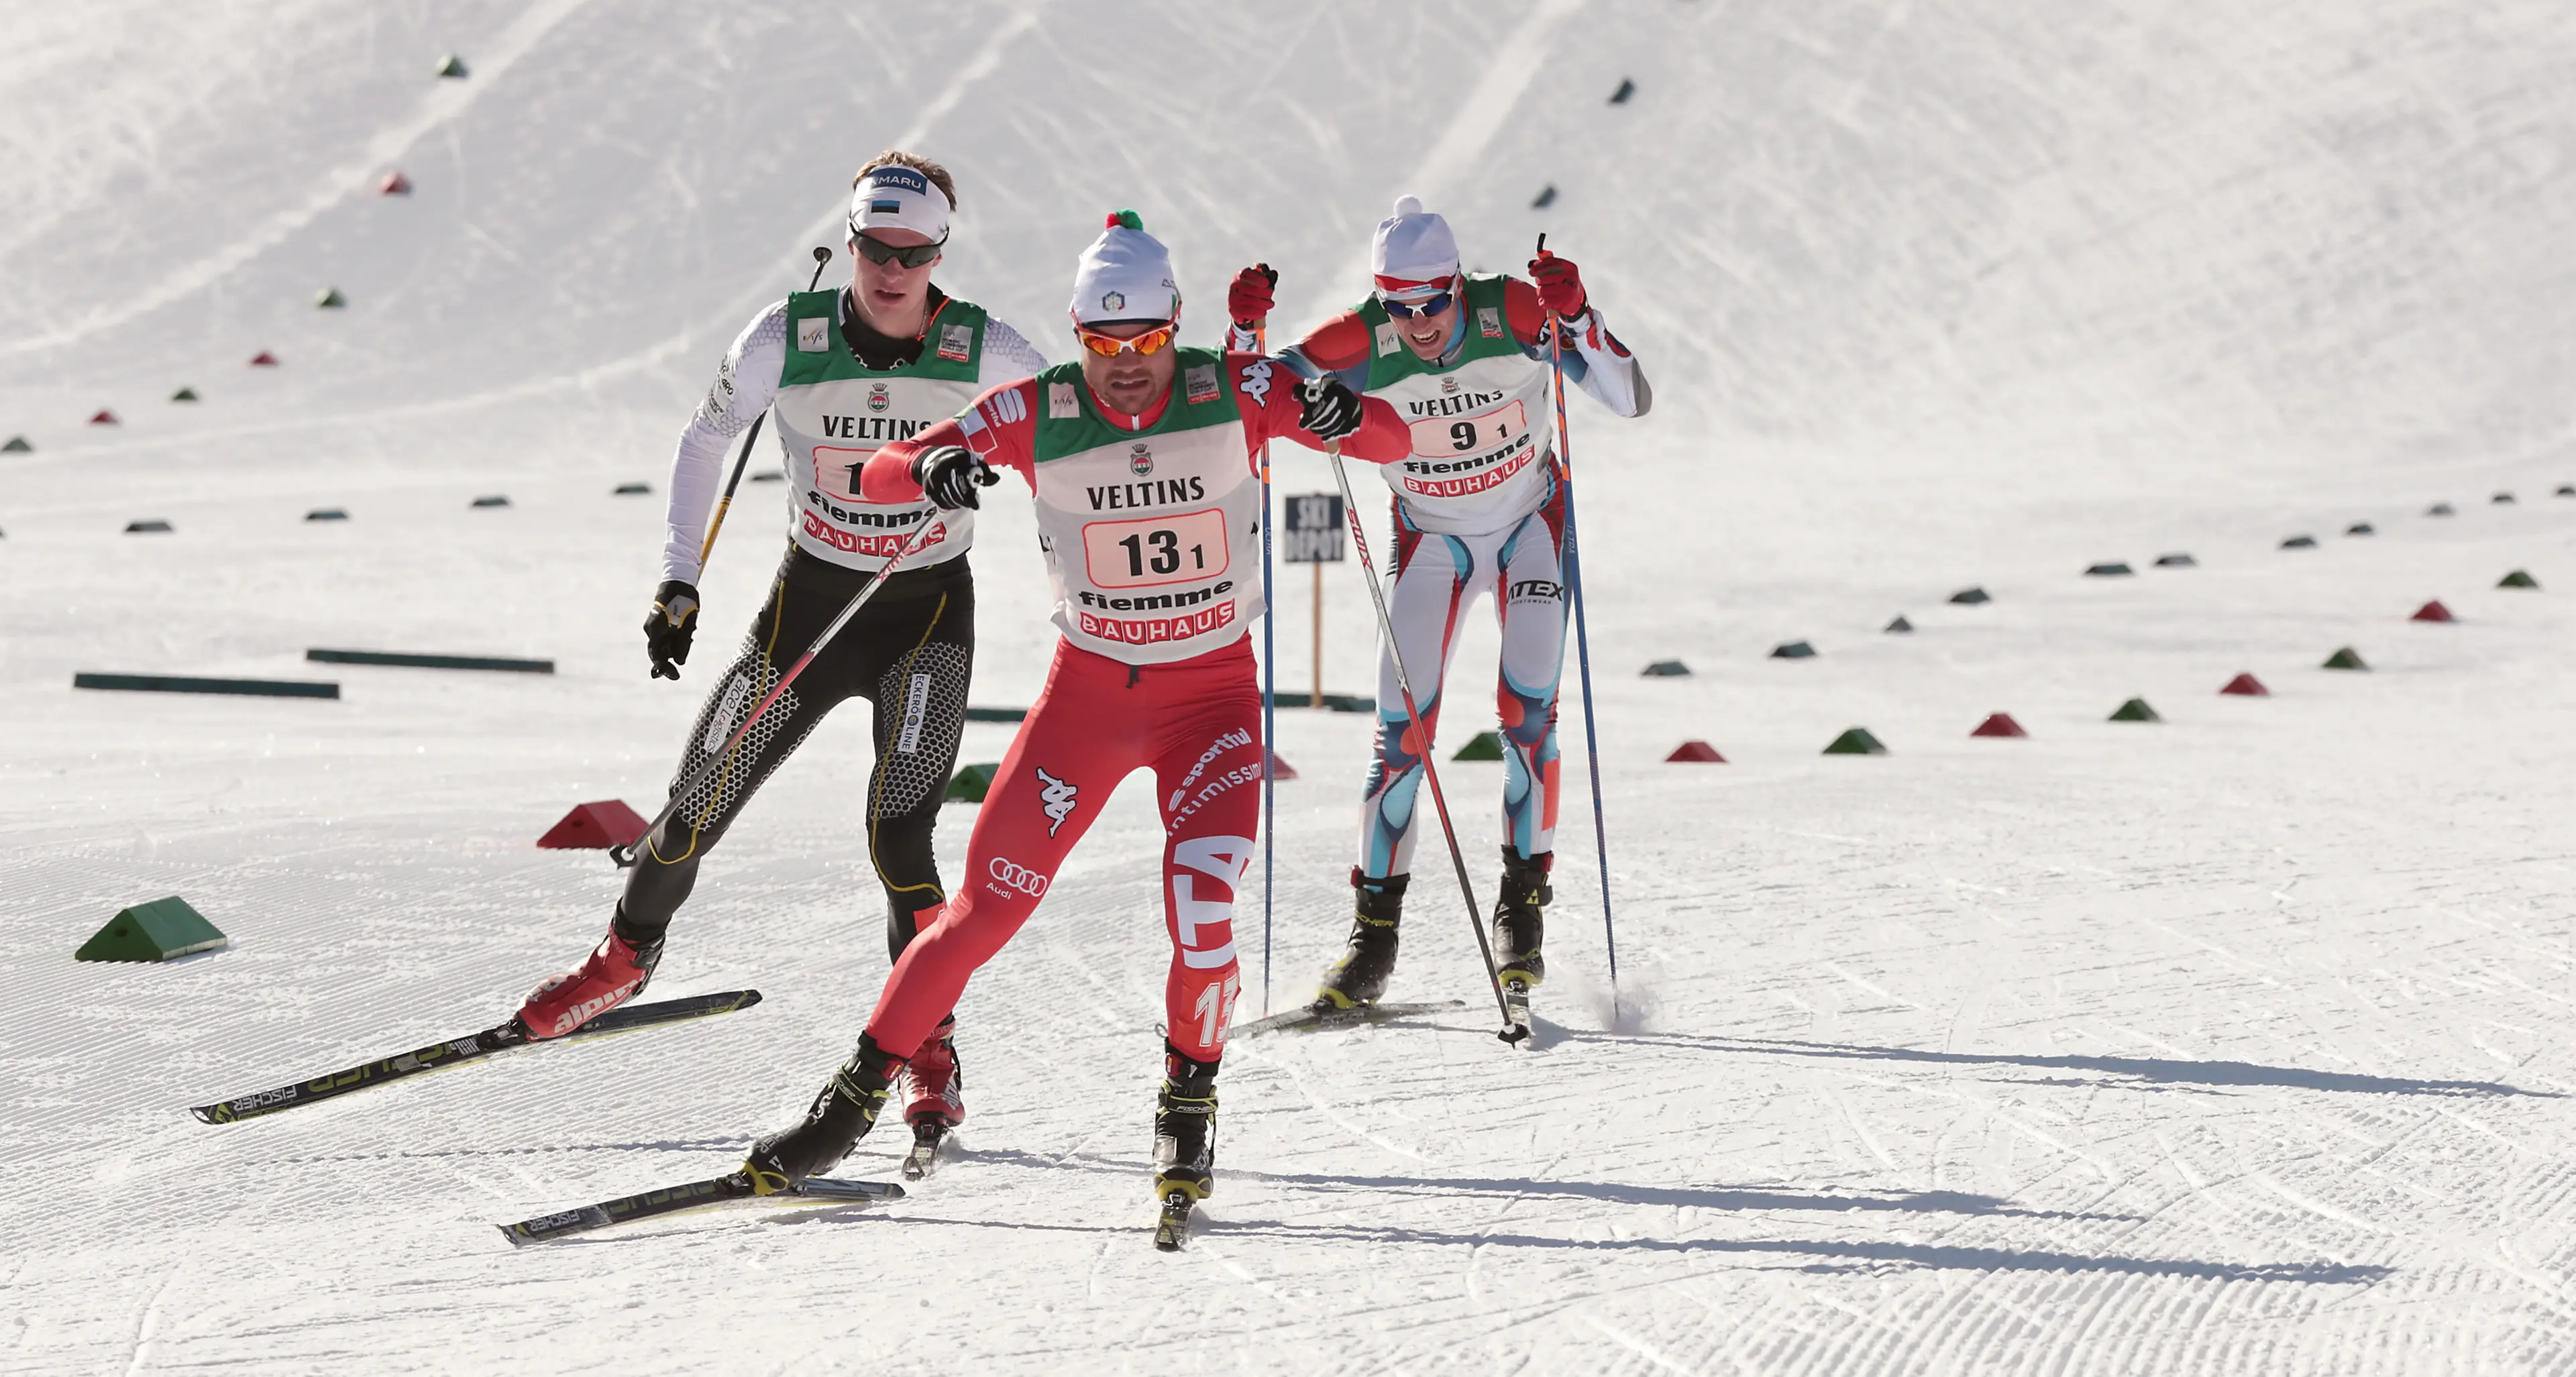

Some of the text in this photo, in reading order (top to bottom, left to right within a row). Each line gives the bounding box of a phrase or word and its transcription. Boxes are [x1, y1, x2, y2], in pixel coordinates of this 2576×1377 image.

[1409, 390, 1503, 416] VELTINS
[1450, 422, 1507, 450] 9 1
[1403, 433, 1530, 474] fiemme
[1407, 448, 1534, 495] BAUHAUS
[1087, 476, 1205, 510] VELTINS
[1297, 497, 1330, 528] SKI
[1119, 530, 1204, 577] 13 1
[1078, 580, 1233, 611] fiemme
[1081, 602, 1234, 642] BAUHAUS
[726, 679, 745, 710] ace
[1182, 727, 1252, 787] sportful
[986, 882, 1012, 900] Audi
[1173, 835, 1255, 969] ITA
[1194, 974, 1238, 1047] 13
[231, 1085, 297, 1111] FISCHER
[527, 1209, 581, 1231] FISCHER
